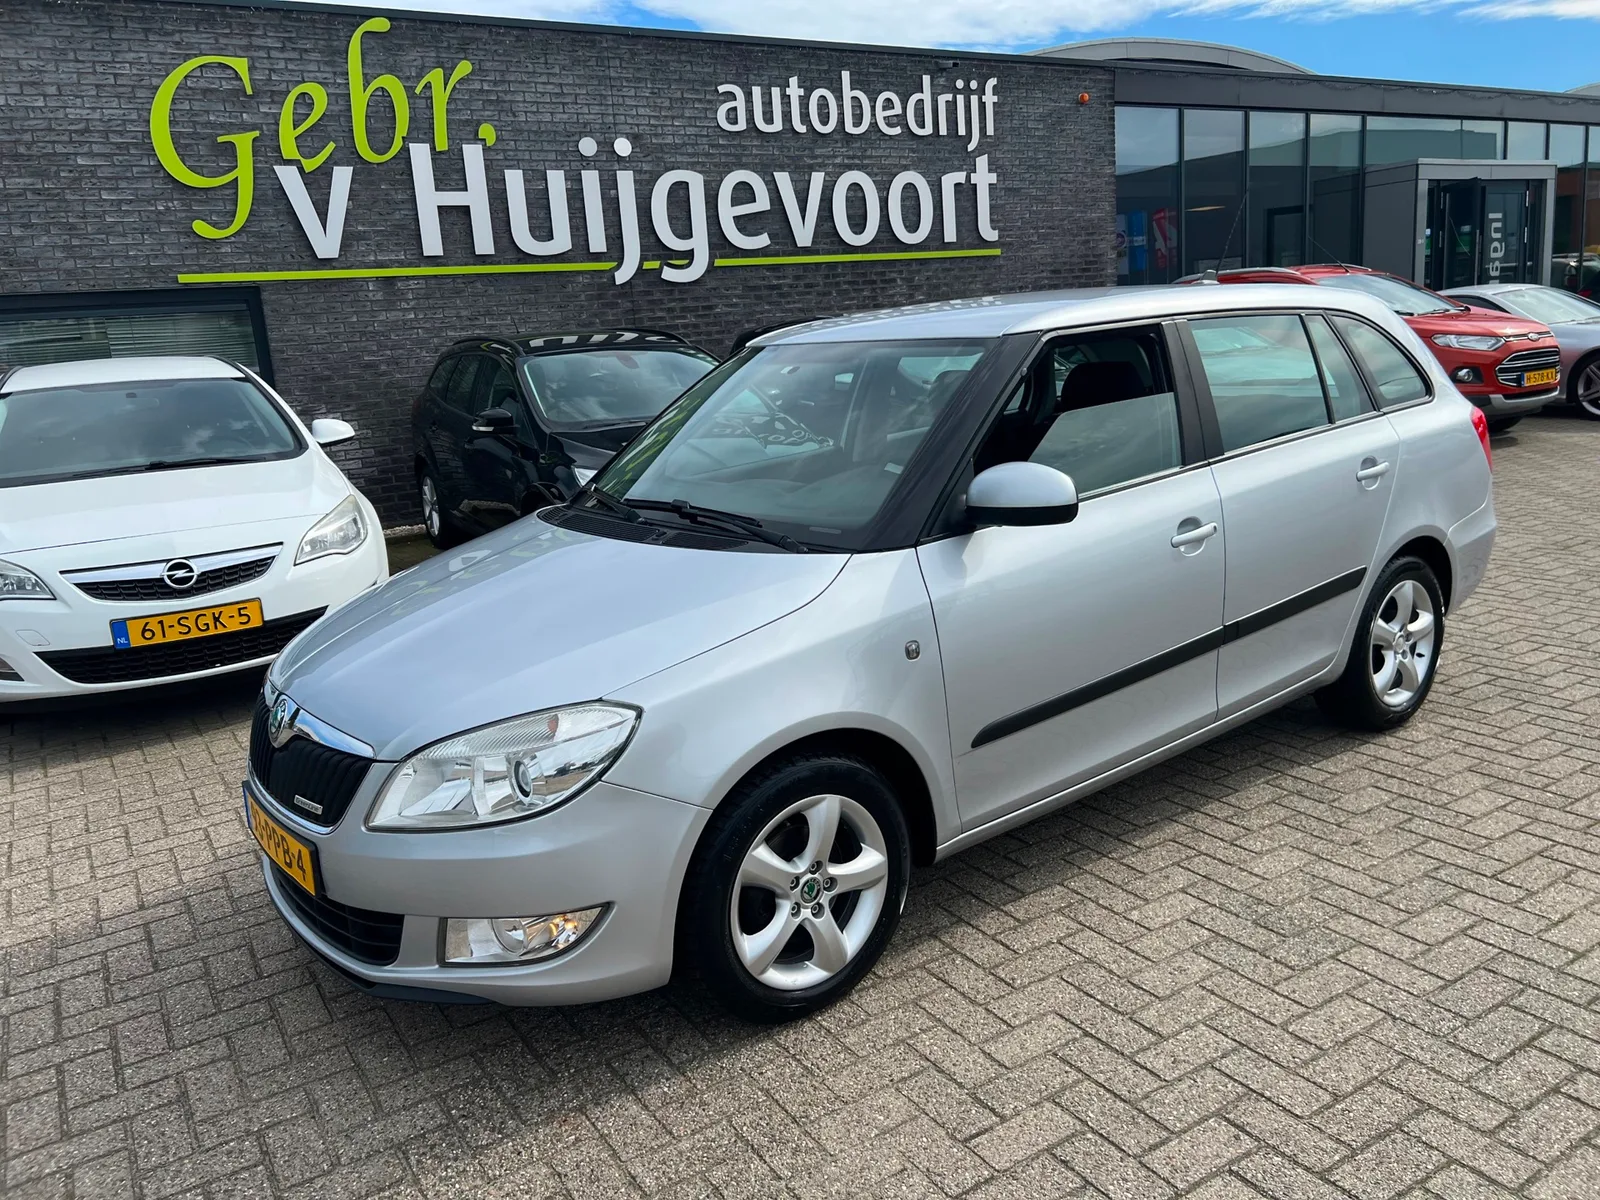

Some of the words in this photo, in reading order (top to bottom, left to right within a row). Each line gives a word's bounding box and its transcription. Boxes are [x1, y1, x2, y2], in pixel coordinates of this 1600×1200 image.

[149, 16, 497, 240] Gebr.
[715, 69, 999, 153] autobedrijf
[273, 165, 354, 260] v
[408, 136, 1000, 285] Huijgevoort
[117, 637, 129, 645] NL
[140, 606, 251, 641] 61-SGK-5
